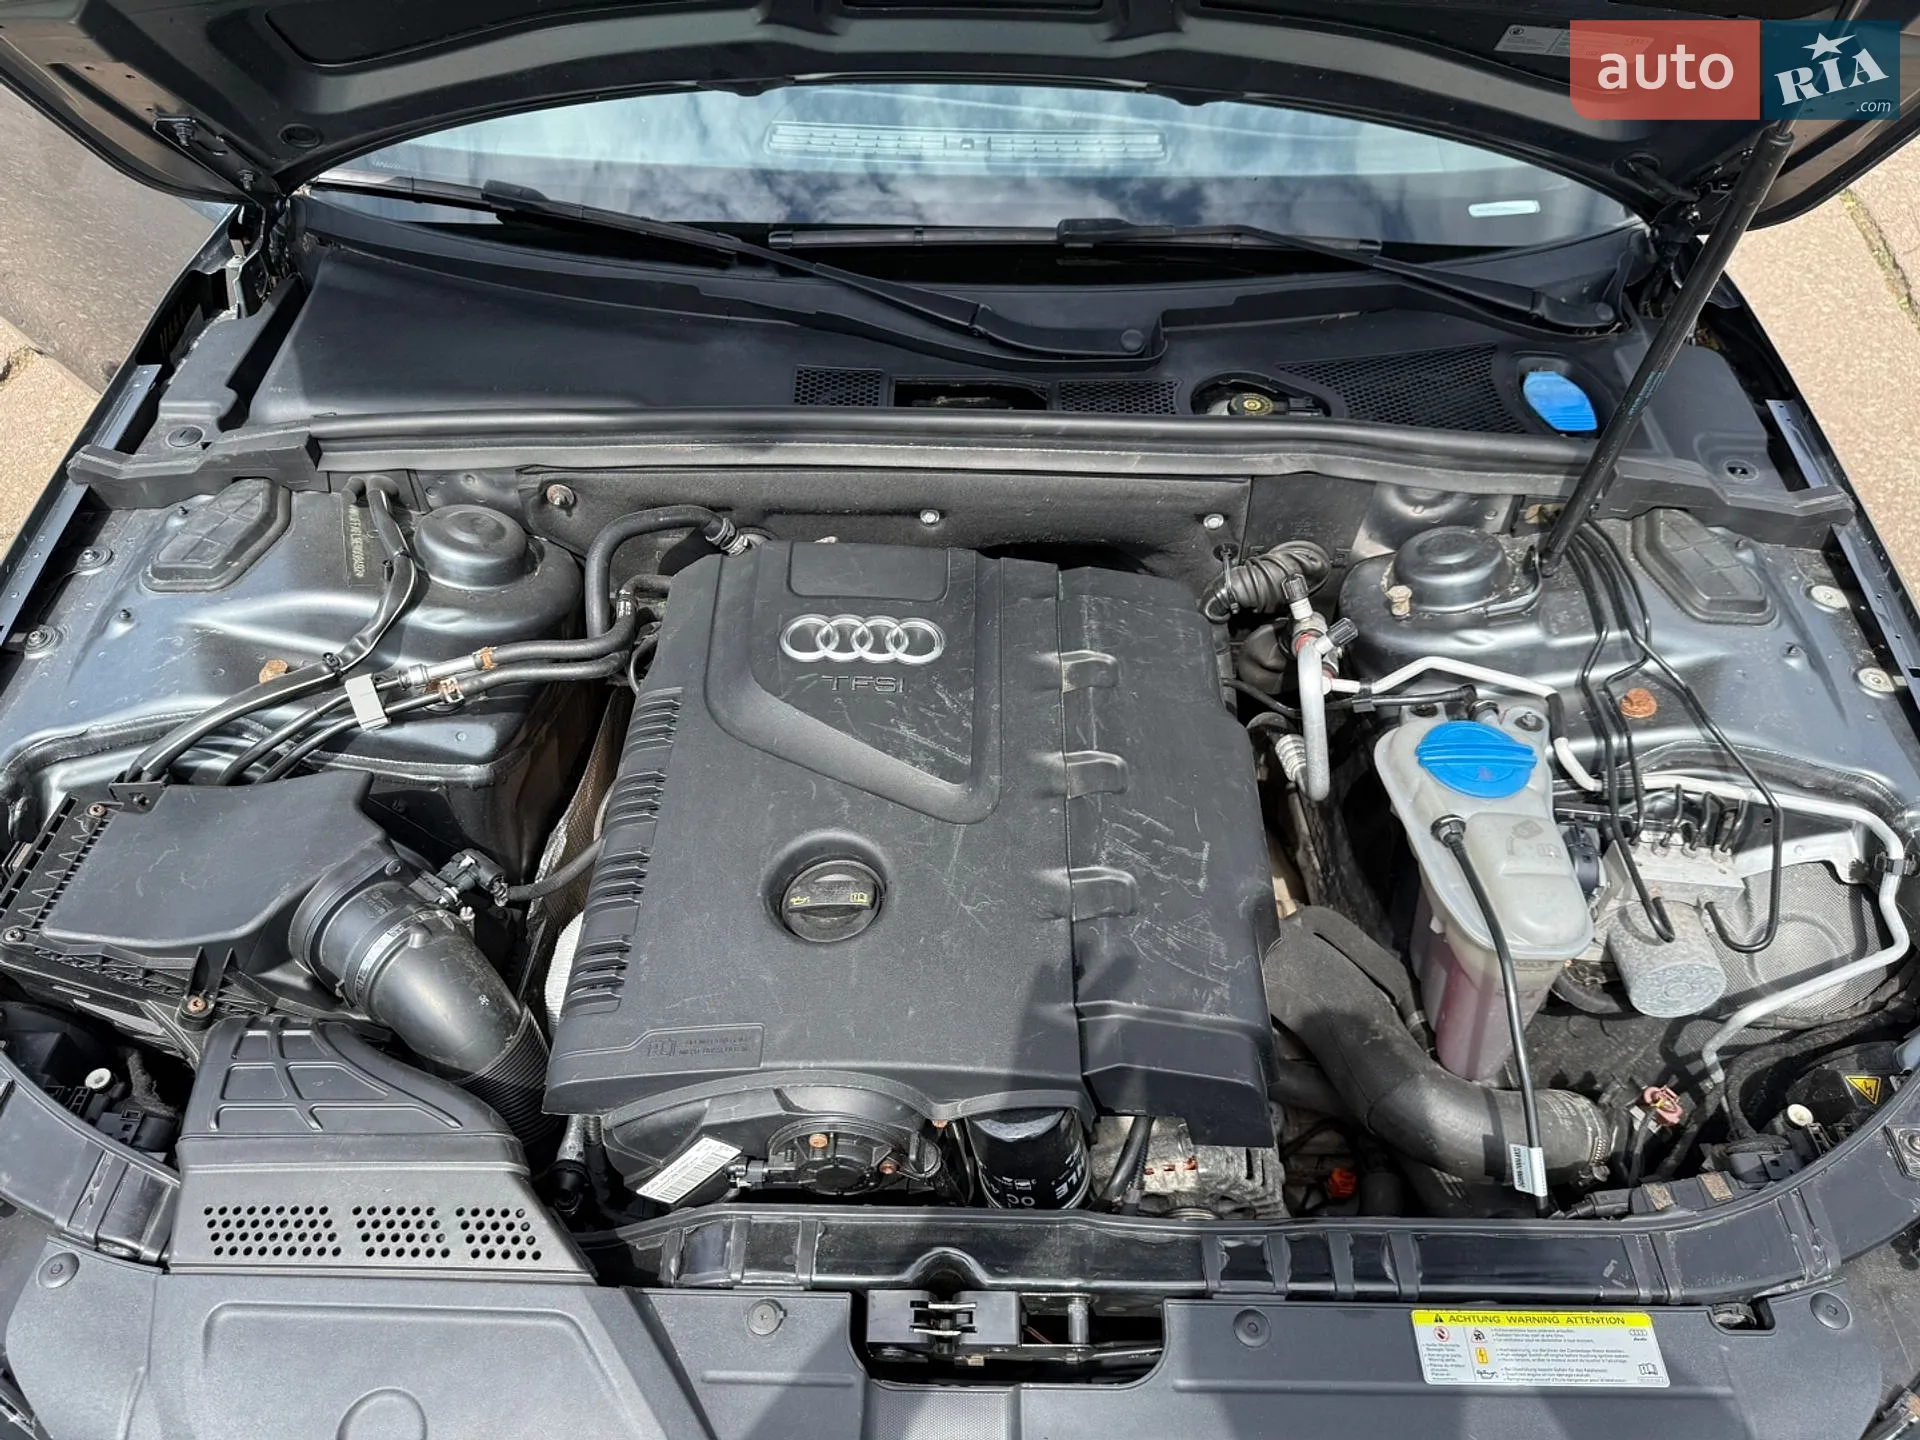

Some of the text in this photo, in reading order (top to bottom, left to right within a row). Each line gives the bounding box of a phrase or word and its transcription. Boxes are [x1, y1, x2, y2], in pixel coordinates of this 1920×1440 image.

[821, 674, 905, 694] TFSI
[1448, 1314, 1626, 1325] ACHTUNG WARNING ATTENTION
